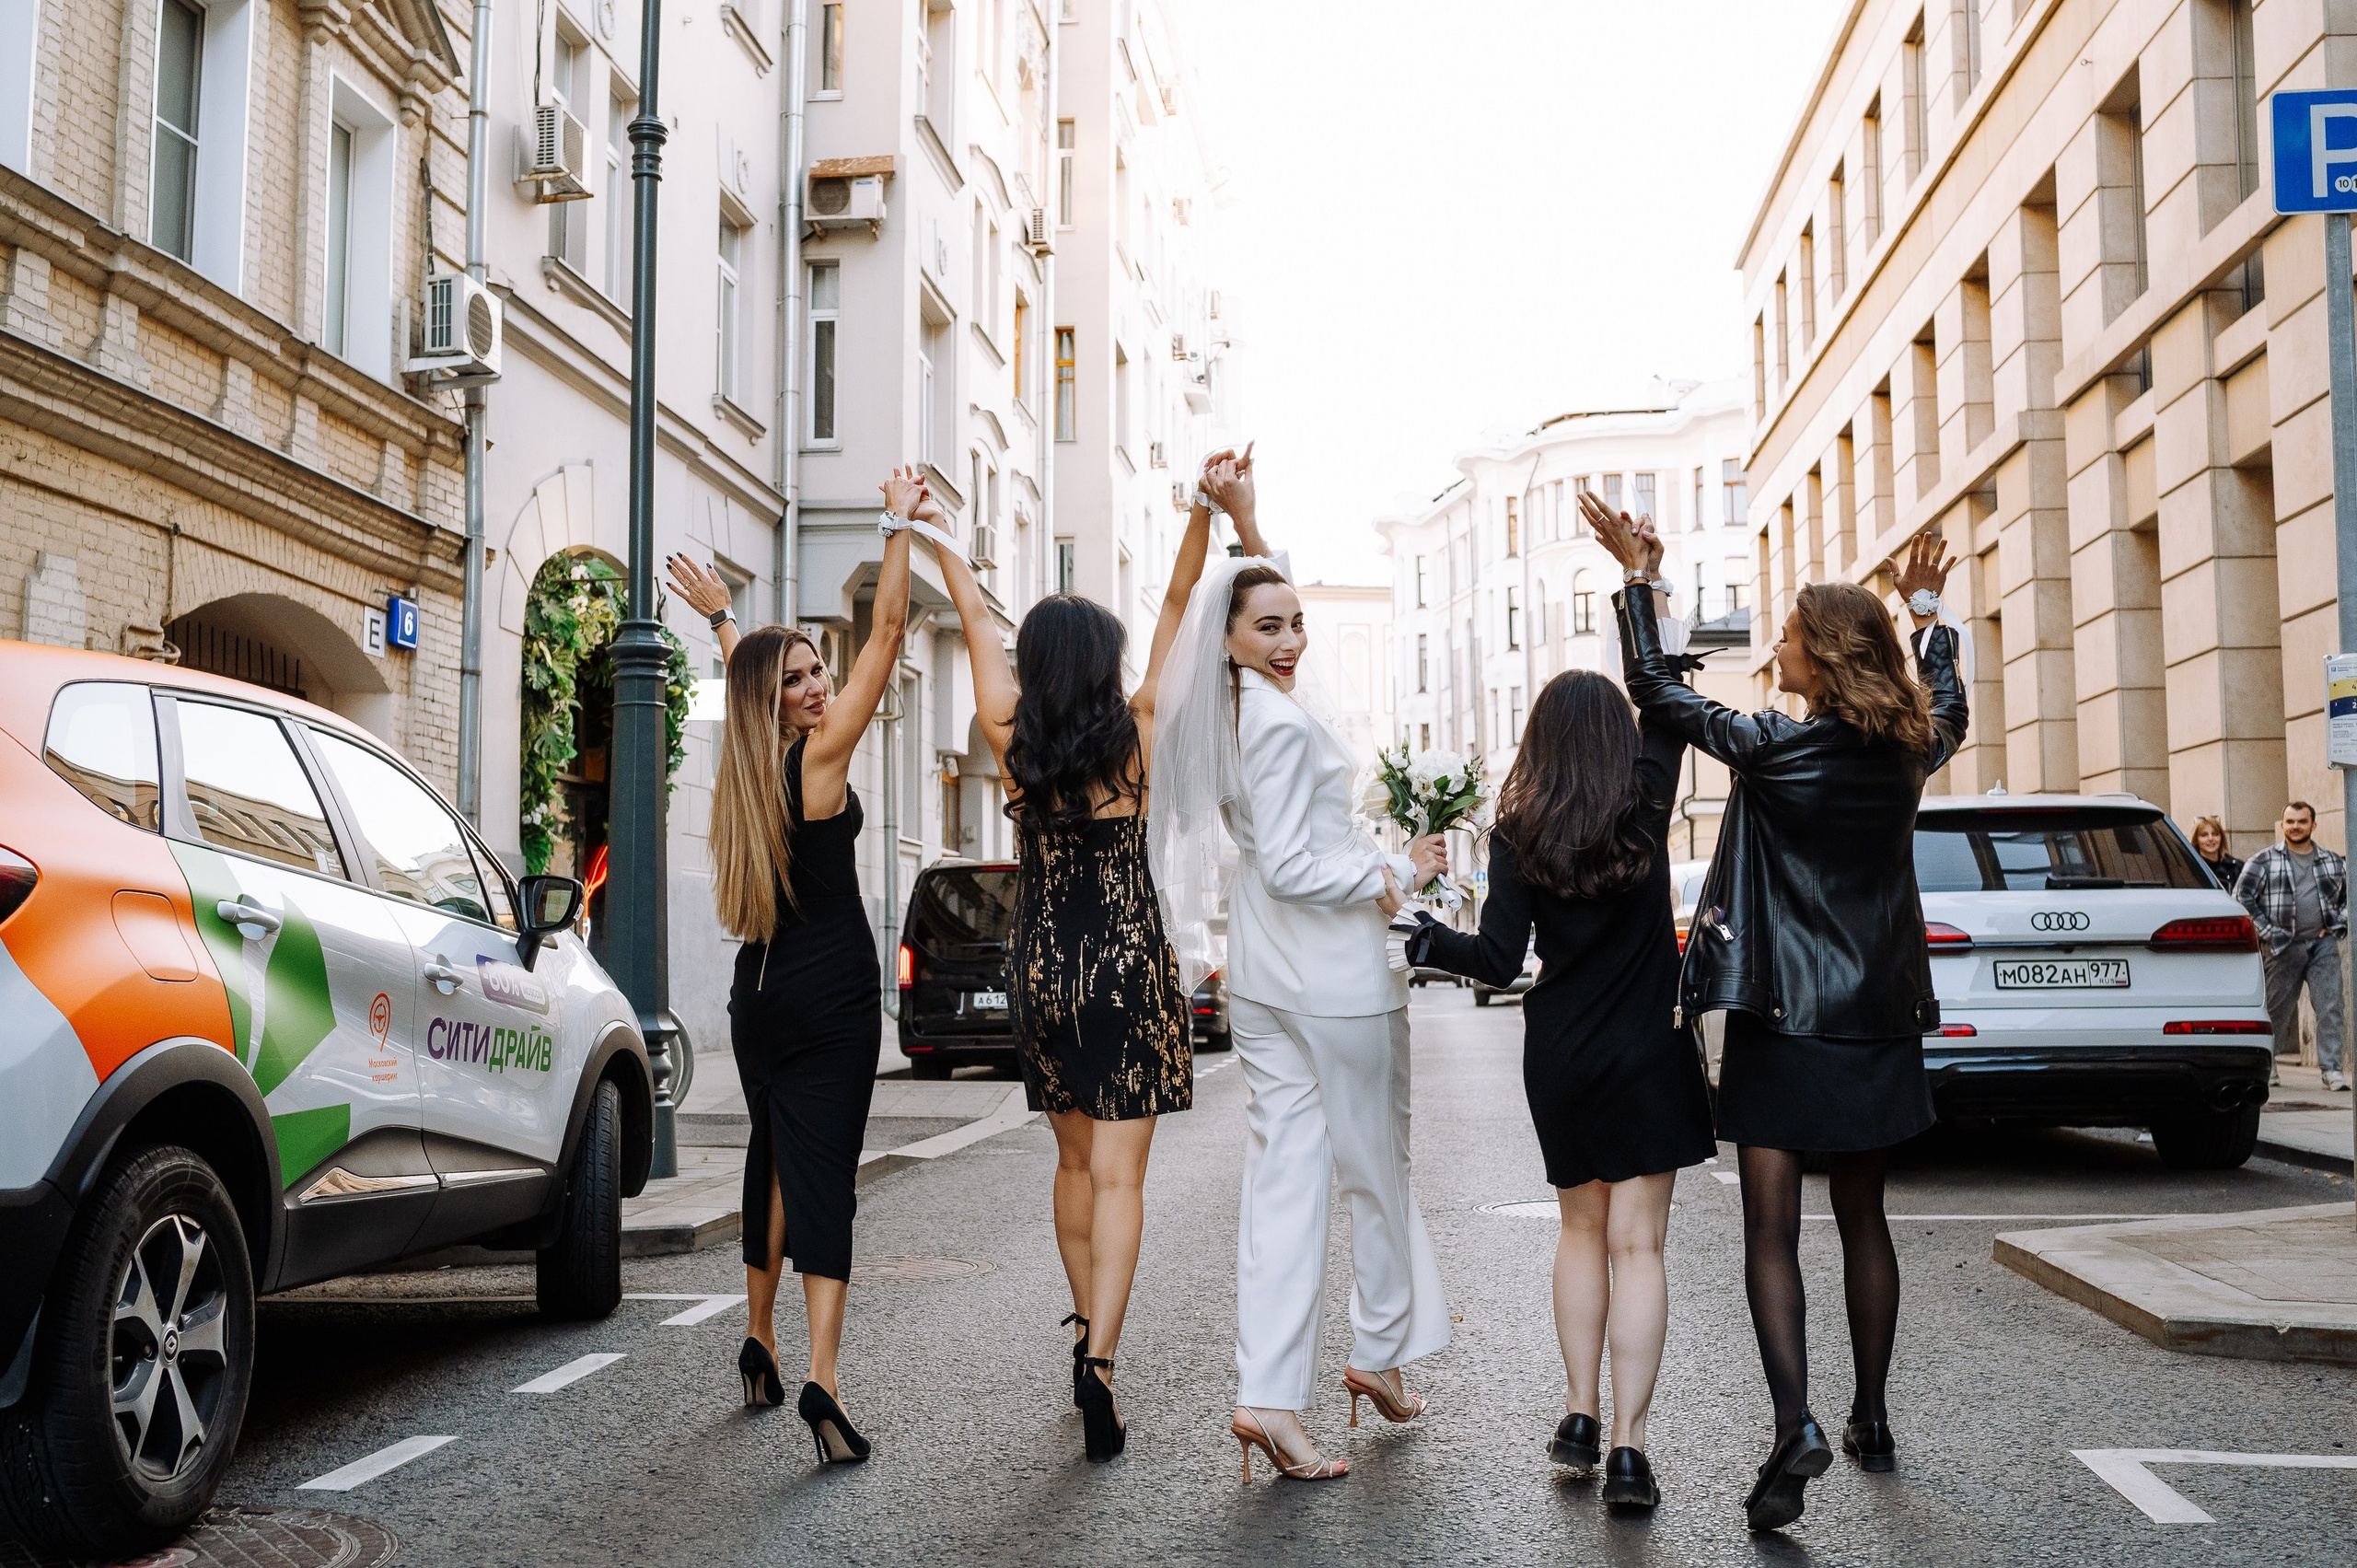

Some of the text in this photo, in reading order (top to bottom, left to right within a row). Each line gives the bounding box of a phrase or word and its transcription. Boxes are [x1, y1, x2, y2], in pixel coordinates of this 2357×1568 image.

[2310, 103, 2357, 198] P
[2339, 179, 2349, 188] 10
[369, 618, 380, 650] Е
[404, 611, 413, 636] 6
[2003, 962, 2120, 984] М082АН 977
[427, 1017, 552, 1074] СИТИДРАЙВ
[369, 1057, 398, 1068] Московский
[372, 1073, 398, 1084] каршеринг
